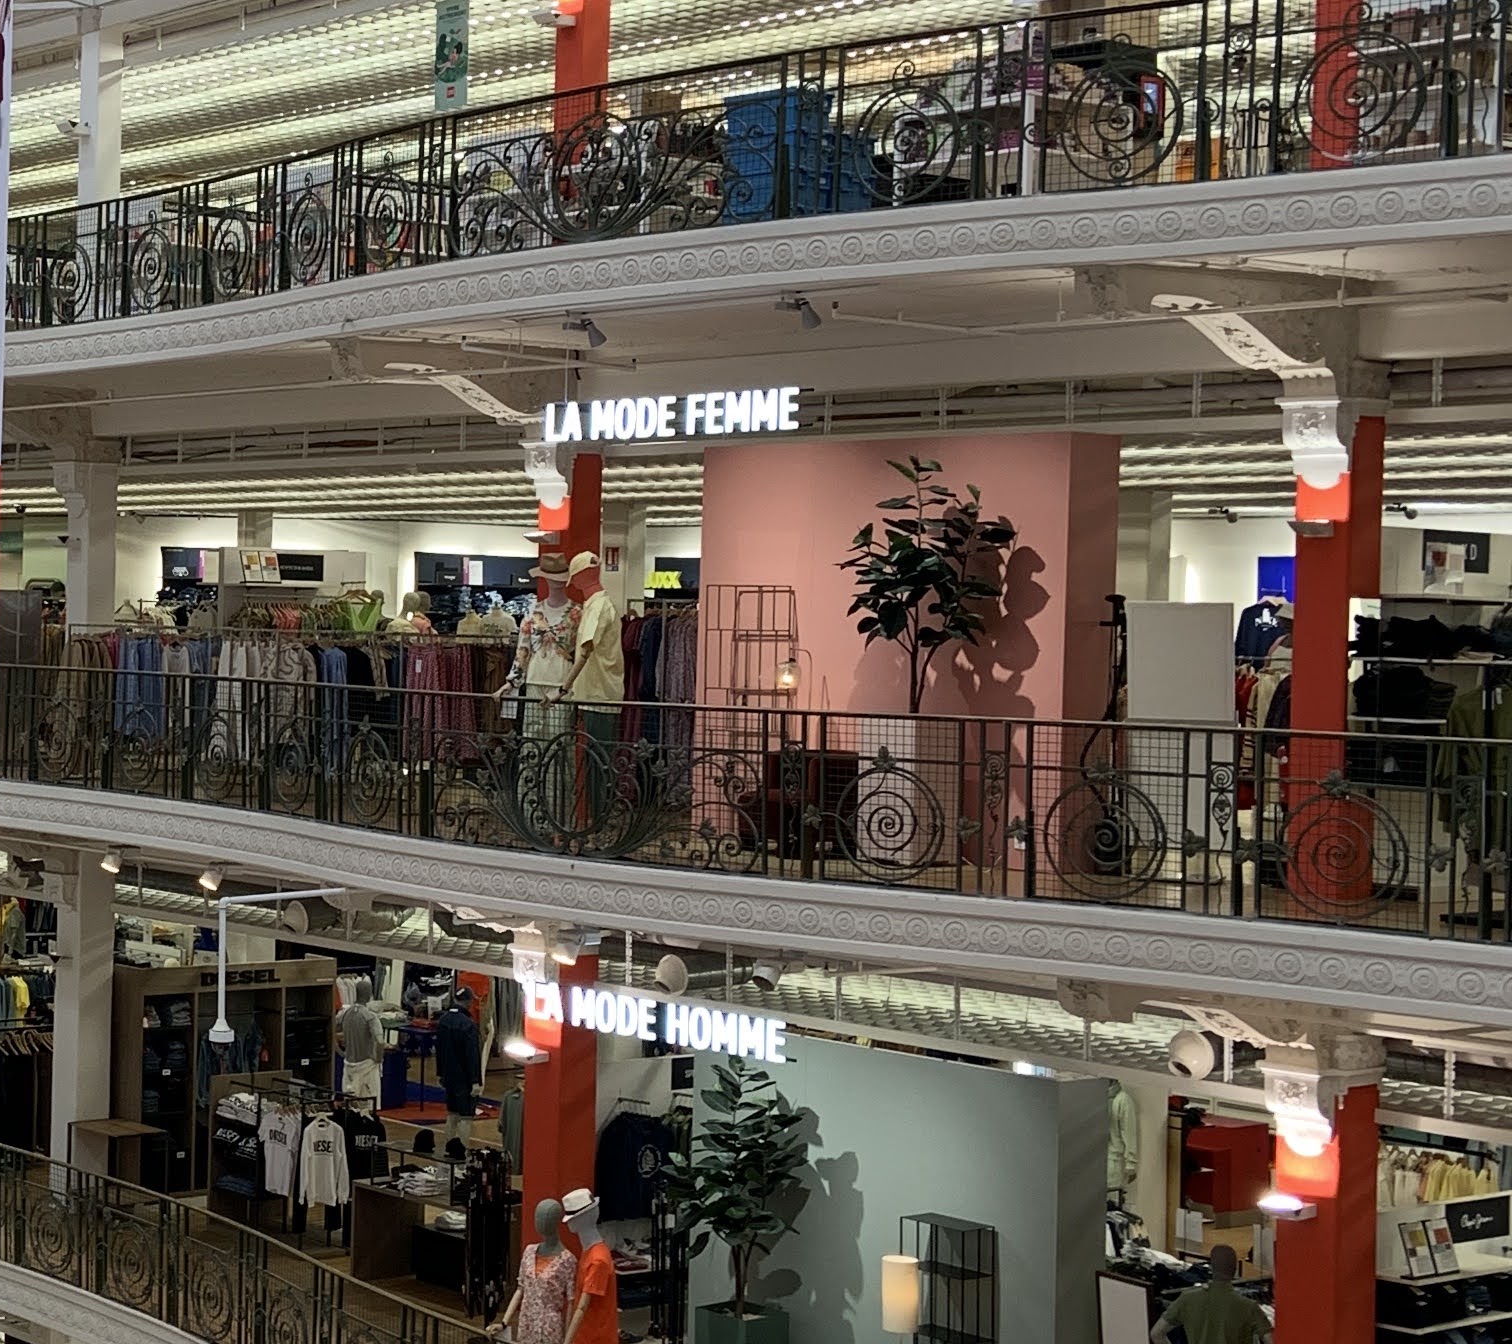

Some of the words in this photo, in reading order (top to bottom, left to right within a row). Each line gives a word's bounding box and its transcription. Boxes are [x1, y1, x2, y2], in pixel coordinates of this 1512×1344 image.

[544, 401, 583, 443] LA
[589, 395, 678, 441] MODE
[685, 386, 801, 436] FEMME
[200, 968, 281, 987] DESEL
[524, 981, 564, 1024] LA
[570, 986, 658, 1042] MODE
[665, 1003, 787, 1064] HOMME
